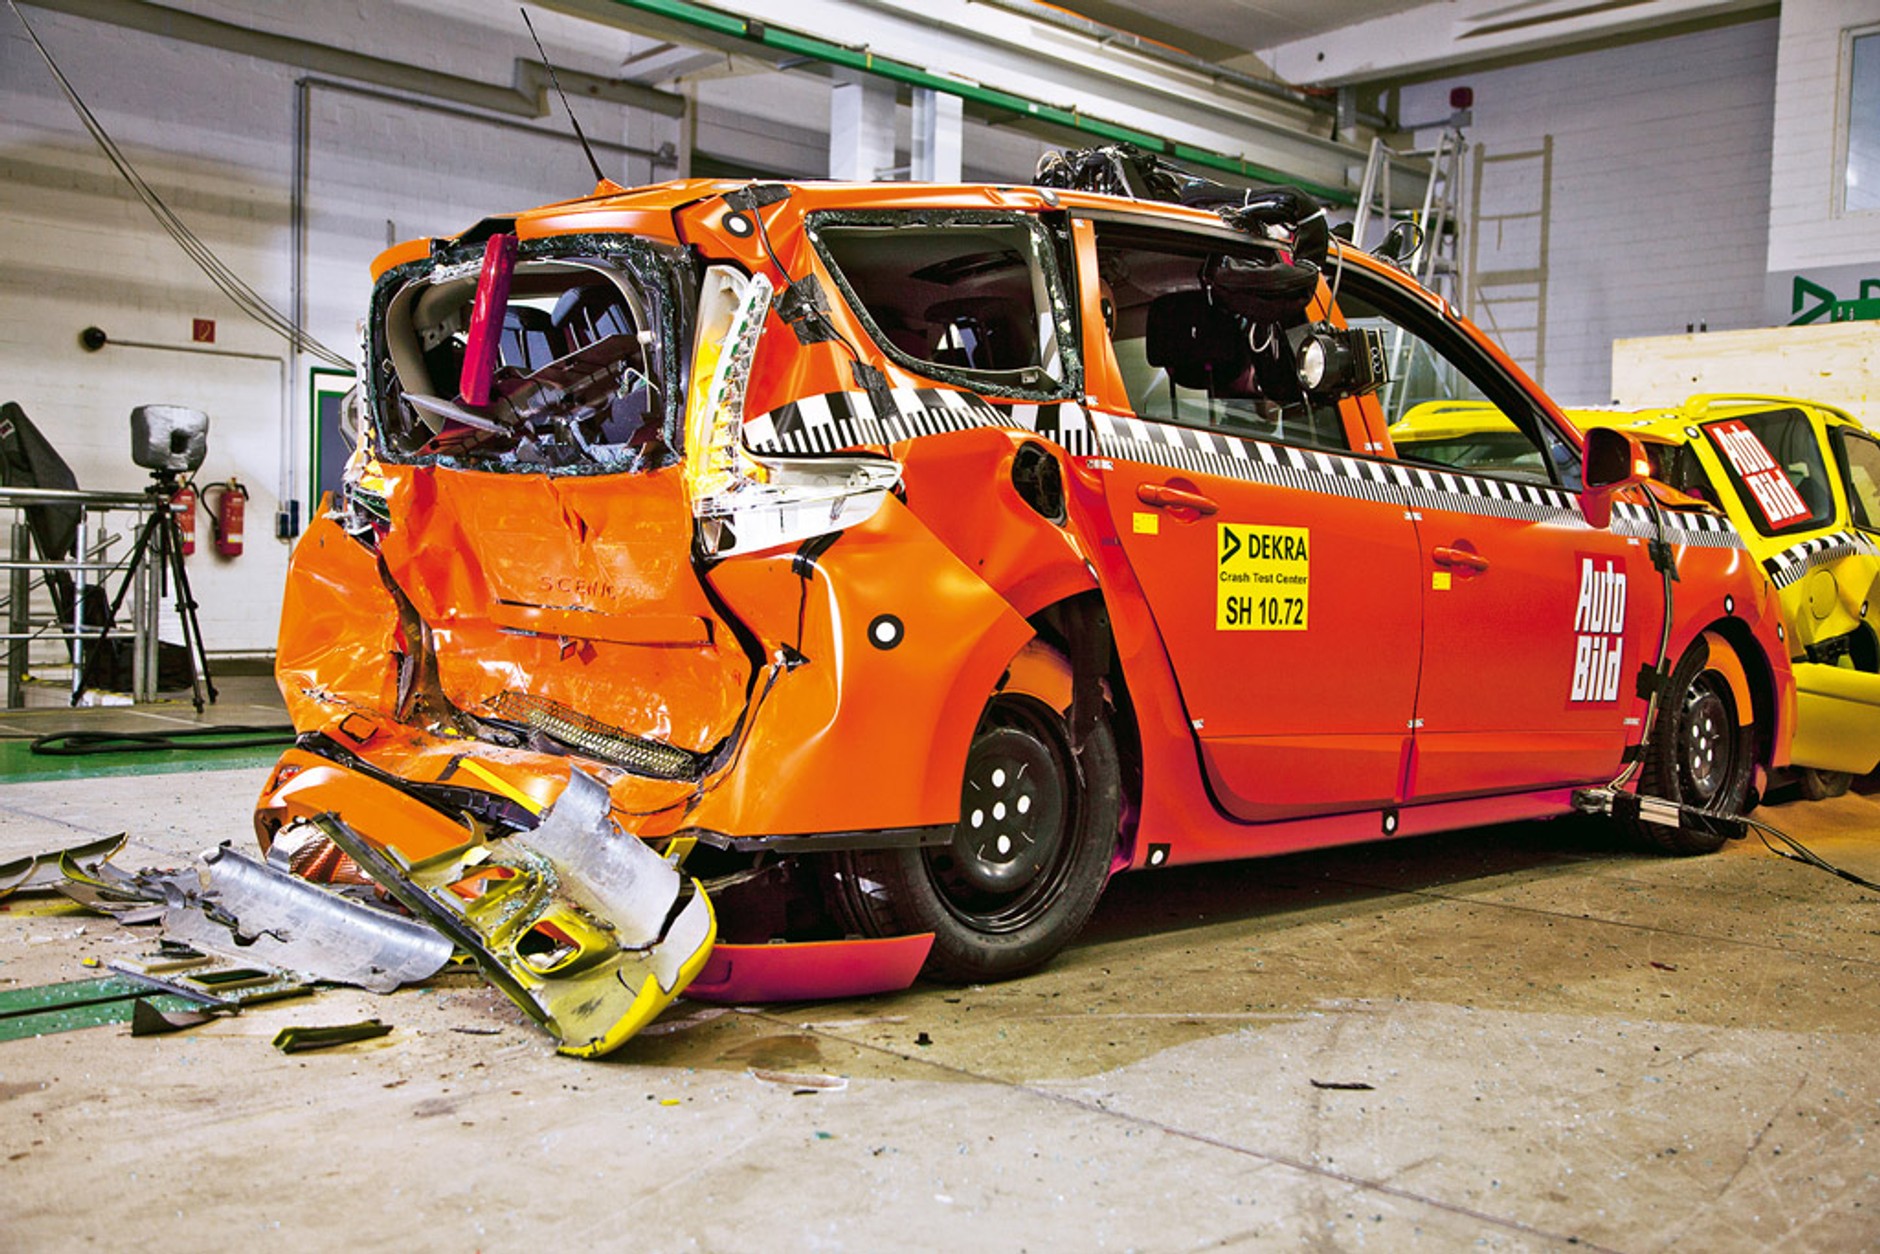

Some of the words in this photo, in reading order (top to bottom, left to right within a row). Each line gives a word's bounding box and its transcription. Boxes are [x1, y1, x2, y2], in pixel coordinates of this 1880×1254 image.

[1712, 424, 1775, 476] Auto
[1745, 469, 1806, 522] Bild
[1248, 534, 1308, 560] DEKRA
[1219, 571, 1250, 583] Crash
[1253, 573, 1274, 584] Test
[1276, 573, 1308, 585] Center
[1574, 558, 1626, 634] Auto
[1226, 596, 1252, 624] SH
[1259, 598, 1304, 625] 10.72
[1571, 635, 1623, 701] Bild
